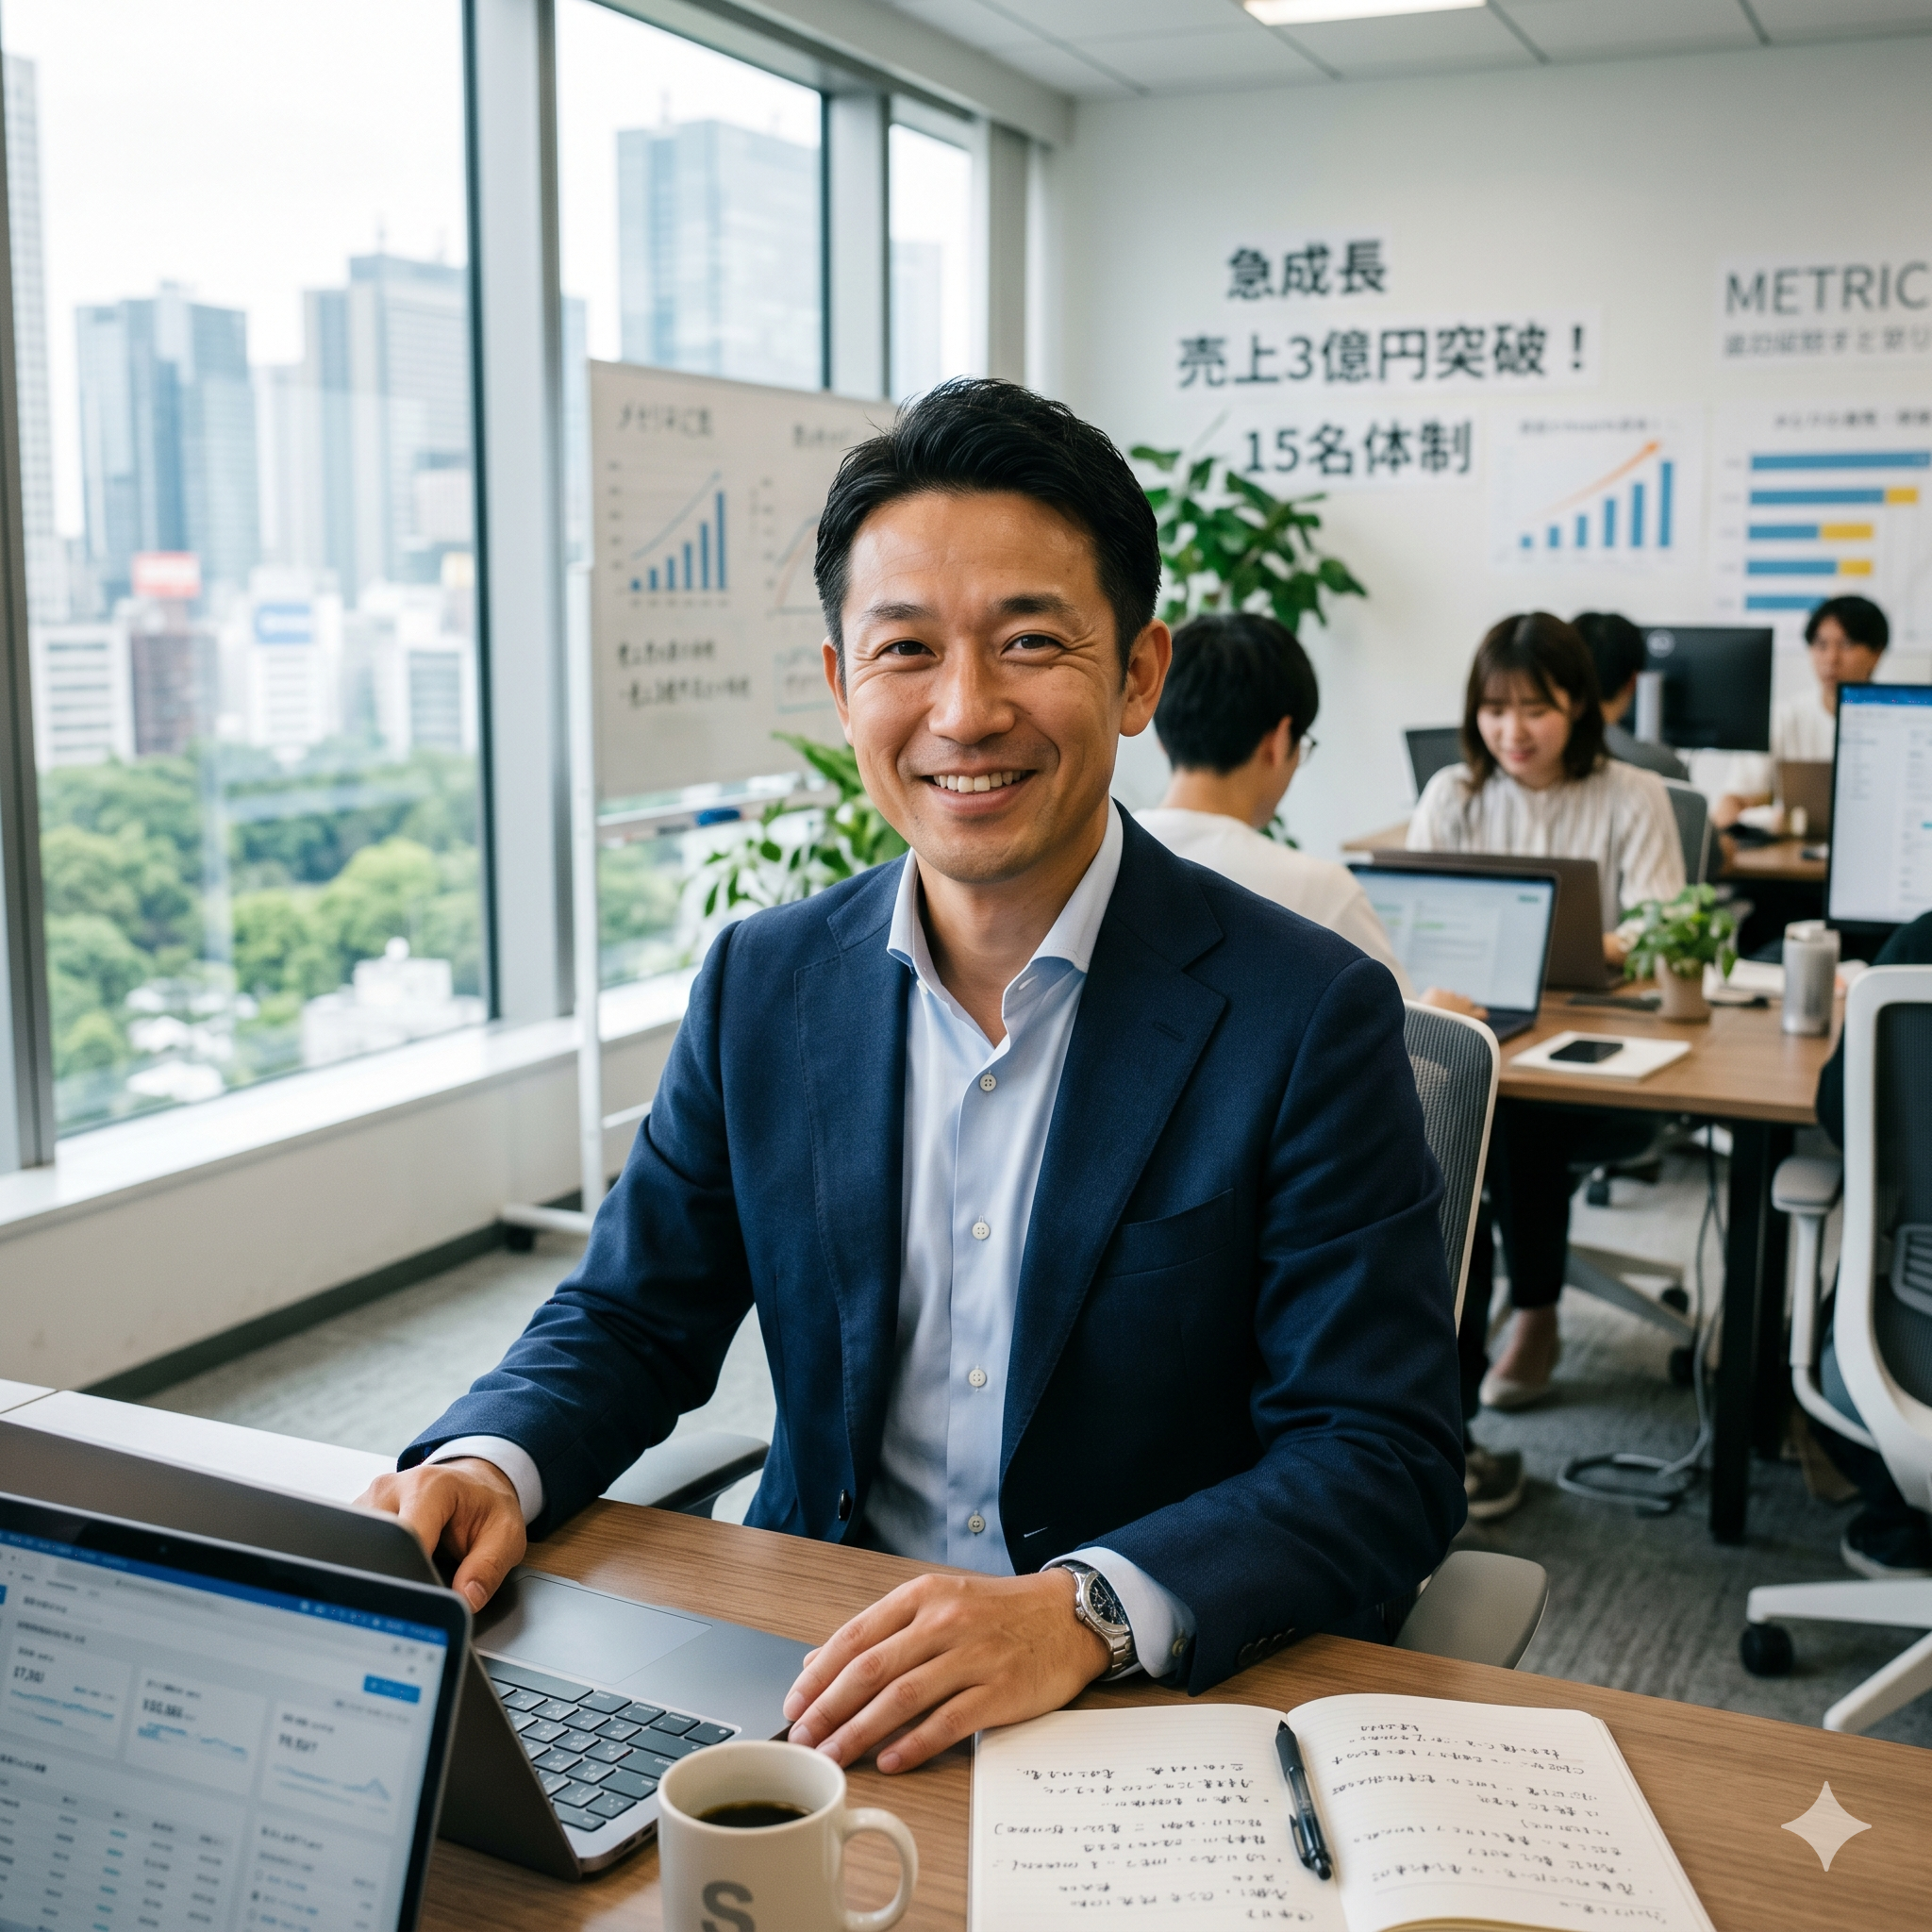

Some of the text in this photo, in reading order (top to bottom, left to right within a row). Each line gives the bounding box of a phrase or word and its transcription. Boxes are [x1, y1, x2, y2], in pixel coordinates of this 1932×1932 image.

[1227, 239, 1386, 300] 急成長
[1725, 260, 1930, 314] METRIC
[1179, 324, 1584, 387] 売上3億円突破！
[1244, 422, 1472, 475] 15名体制
[701, 1880, 756, 1932] S
